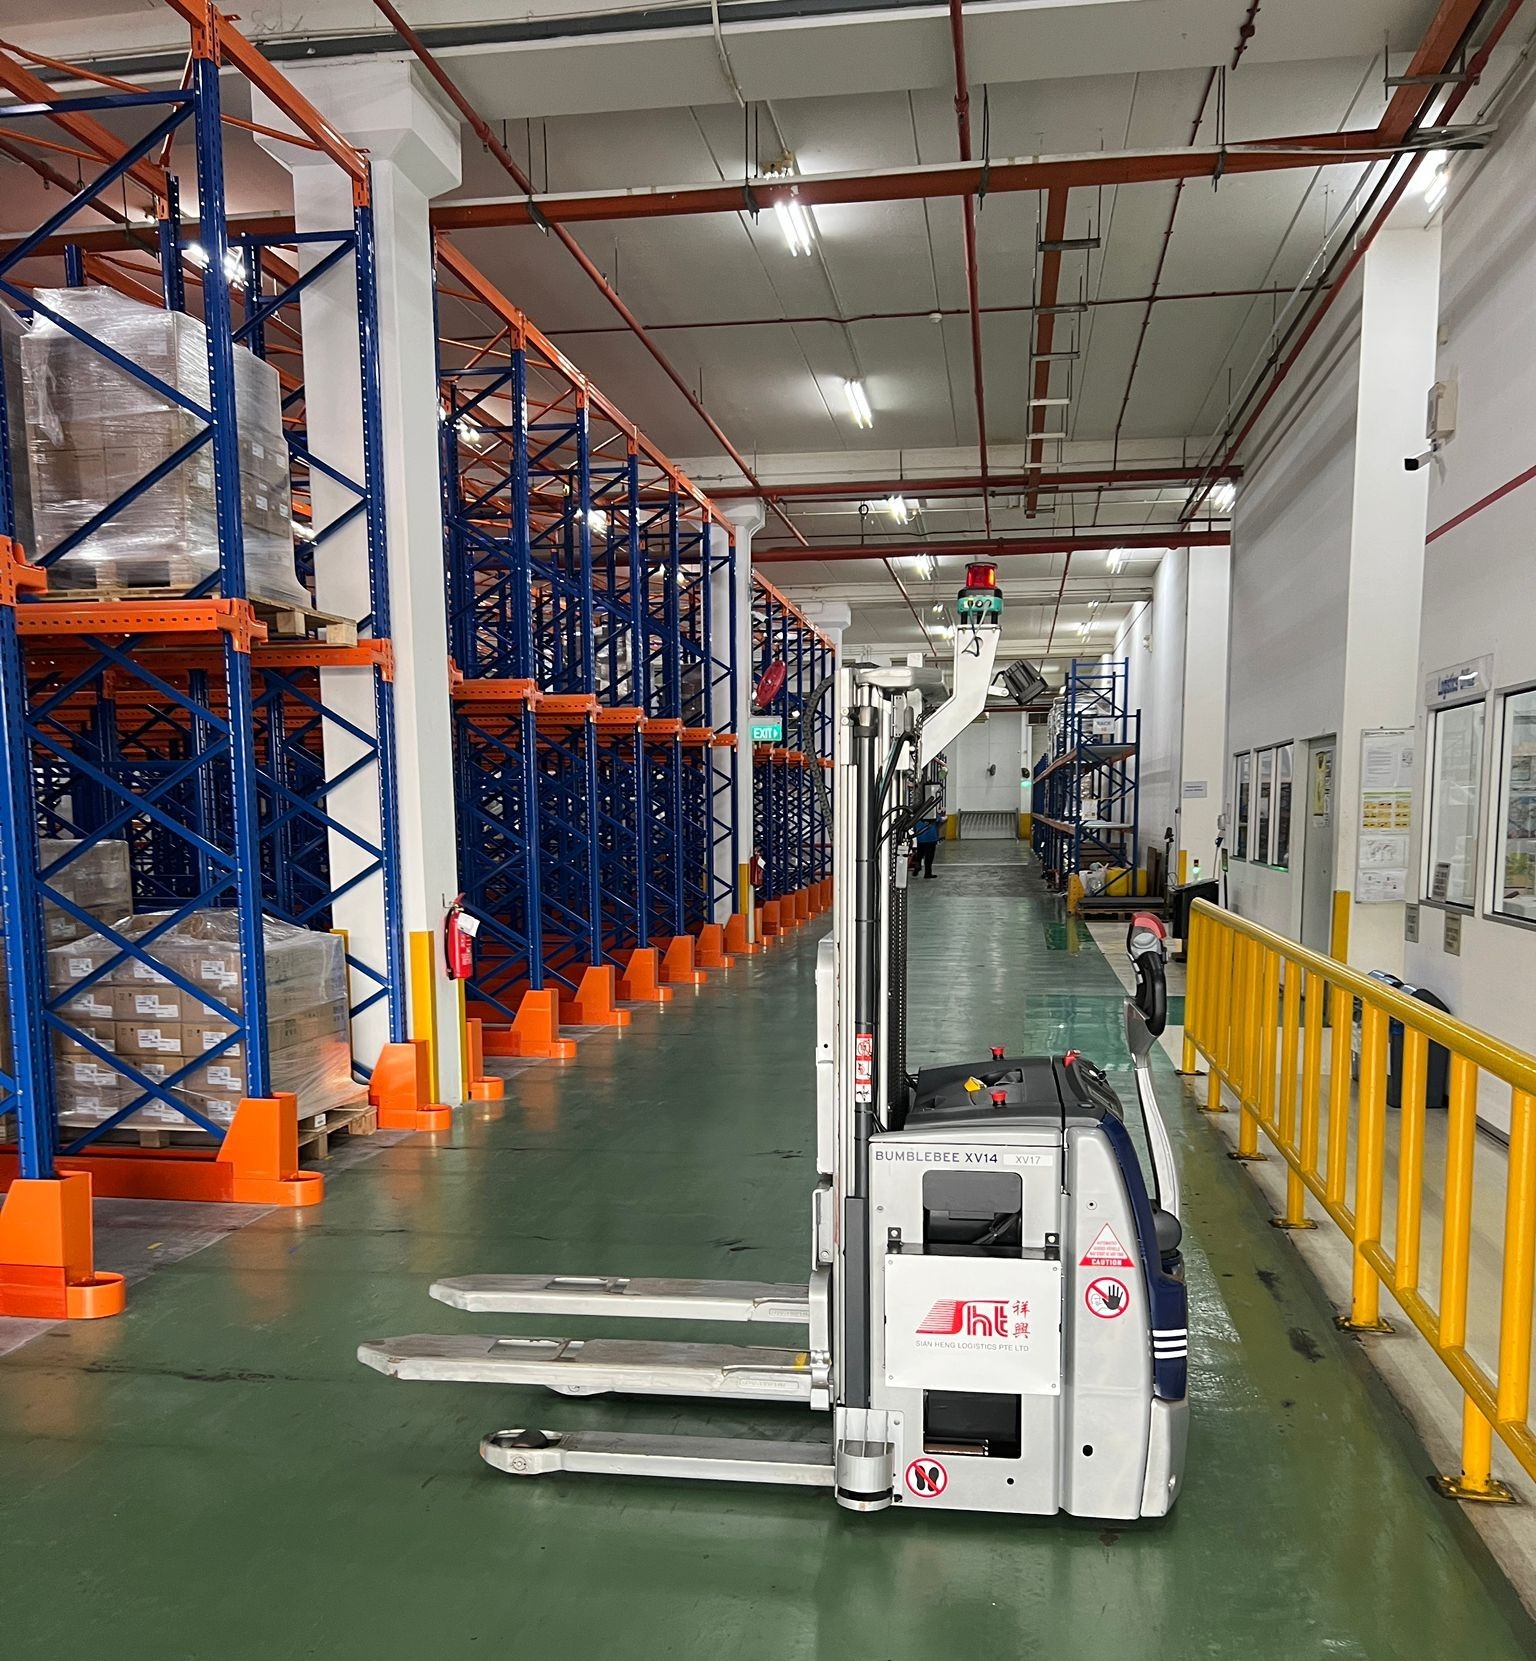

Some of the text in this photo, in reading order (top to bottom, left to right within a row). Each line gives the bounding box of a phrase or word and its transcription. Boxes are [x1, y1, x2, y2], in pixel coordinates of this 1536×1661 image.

[753, 727, 772, 739] EXIT
[876, 1151, 998, 1163] BUMBLEBEE XV14
[1015, 1156, 1041, 1165] XV17
[1091, 1258, 1122, 1266] CAUTION
[934, 1341, 956, 1349] HENG
[957, 1342, 997, 1350] LOGISTICS
[998, 1344, 1013, 1352] PTE
